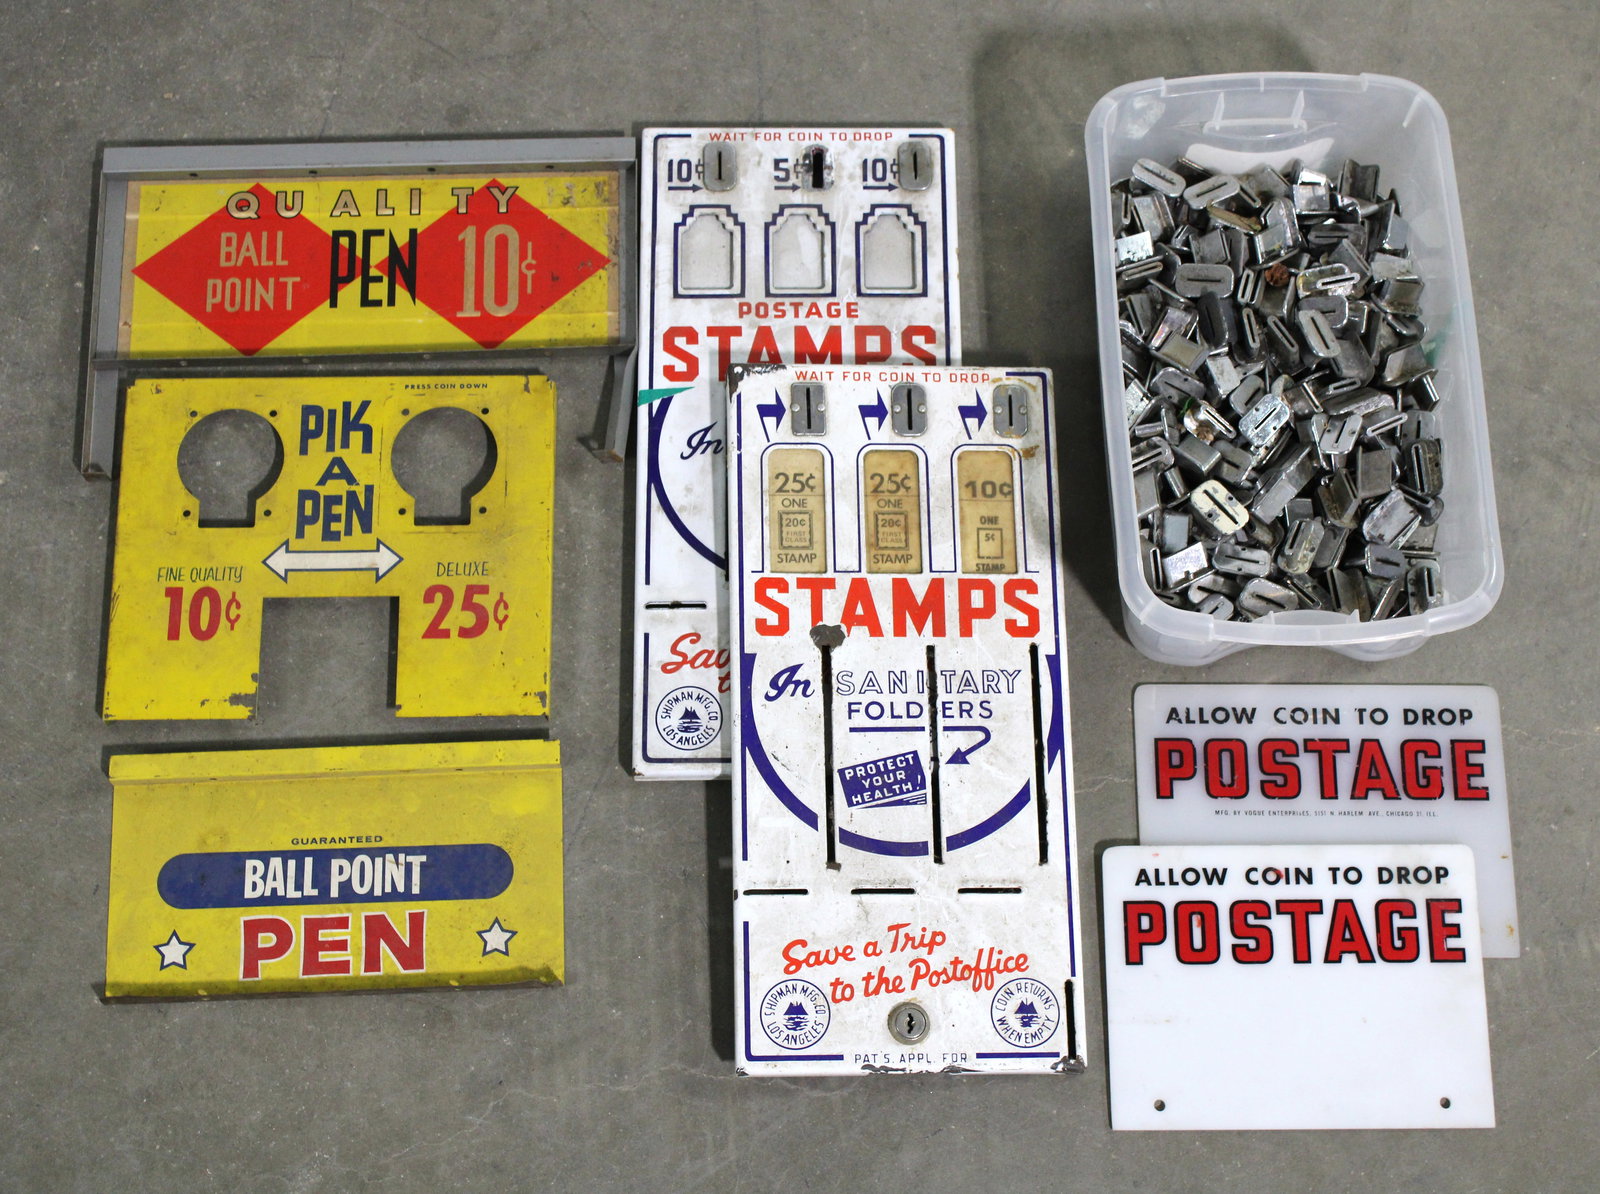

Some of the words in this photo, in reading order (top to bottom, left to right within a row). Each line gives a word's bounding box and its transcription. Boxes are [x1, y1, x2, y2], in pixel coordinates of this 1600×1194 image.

[709, 132, 747, 142] WAIT
[754, 131, 782, 142] FOR
[788, 131, 825, 142] COIN
[830, 131, 848, 141] TO
[852, 131, 894, 141] DROP
[226, 185, 519, 219] QUALITY
[219, 231, 289, 267] BALL
[329, 228, 418, 308] PEN
[456, 224, 537, 318] 10¢
[205, 276, 301, 312] POINT
[737, 301, 859, 319] POSTAGE
[662, 325, 937, 382] STAMPS
[795, 370, 834, 382] WAIT
[842, 371, 872, 382] FOR
[878, 371, 915, 383] COIN
[922, 372, 942, 383] TO
[949, 372, 990, 383] DROP
[299, 400, 373, 456] PIK
[680, 421, 724, 461] In
[315, 456, 360, 486] A
[774, 472, 817, 494] 25¢
[870, 472, 912, 494] 25¢
[964, 480, 1012, 499] 10¢
[295, 484, 374, 542] PEN
[781, 498, 808, 508] ONE
[876, 498, 903, 509] ONE
[784, 518, 806, 527] 20¢
[880, 518, 902, 528] 20¢
[980, 516, 1000, 525] ONE
[435, 561, 490, 577] DELUXE
[777, 553, 817, 563] STAMP
[872, 553, 913, 564] STAMP
[975, 562, 1005, 572] STAMP
[157, 566, 186, 583] FINE
[190, 565, 244, 584] QUALITY
[164, 586, 242, 641] 10¢
[421, 584, 509, 639] 25¢
[754, 577, 1041, 638] STAMPS
[764, 663, 815, 702] In
[835, 669, 1022, 696] SANITARY
[660, 691, 694, 719] SHIPMAN
[847, 700, 994, 720] FOLDERS
[1165, 706, 1257, 725] ALLOW
[1273, 706, 1341, 725] COIN
[1354, 707, 1389, 725] TO
[1403, 707, 1473, 726] DROP
[662, 724, 679, 741] LOS
[676, 725, 716, 746] ANGELES
[844, 754, 915, 780] PROTECT
[861, 770, 906, 789] YOUR
[1153, 737, 1491, 801] POSTAGE
[291, 835, 384, 846] GUARANTEED
[243, 856, 319, 899] BALL
[329, 853, 427, 898] POINT
[1134, 867, 1228, 886] ALLOW
[1244, 867, 1313, 886] COIN
[1328, 867, 1363, 885] TO
[1377, 866, 1450, 885] DROP
[239, 909, 428, 981] PEN
[1122, 898, 1467, 966] POSTAGE
[781, 938, 857, 976] Save
[863, 940, 883, 957] a
[887, 922, 947, 955] Trip
[829, 977, 855, 1004] to
[861, 966, 906, 997] the
[908, 947, 1030, 993] Postoffice
[764, 983, 798, 1016] SHIPMAN
[994, 987, 1015, 1012] COIN
[1015, 981, 1056, 1011] RETURNS
[767, 1021, 785, 1040] LOS
[782, 1020, 825, 1046] ANGELES
[996, 1015, 1023, 1043] WHEN
[1024, 1014, 1056, 1044] EMPTY
[942, 1052, 968, 1063] FOR
